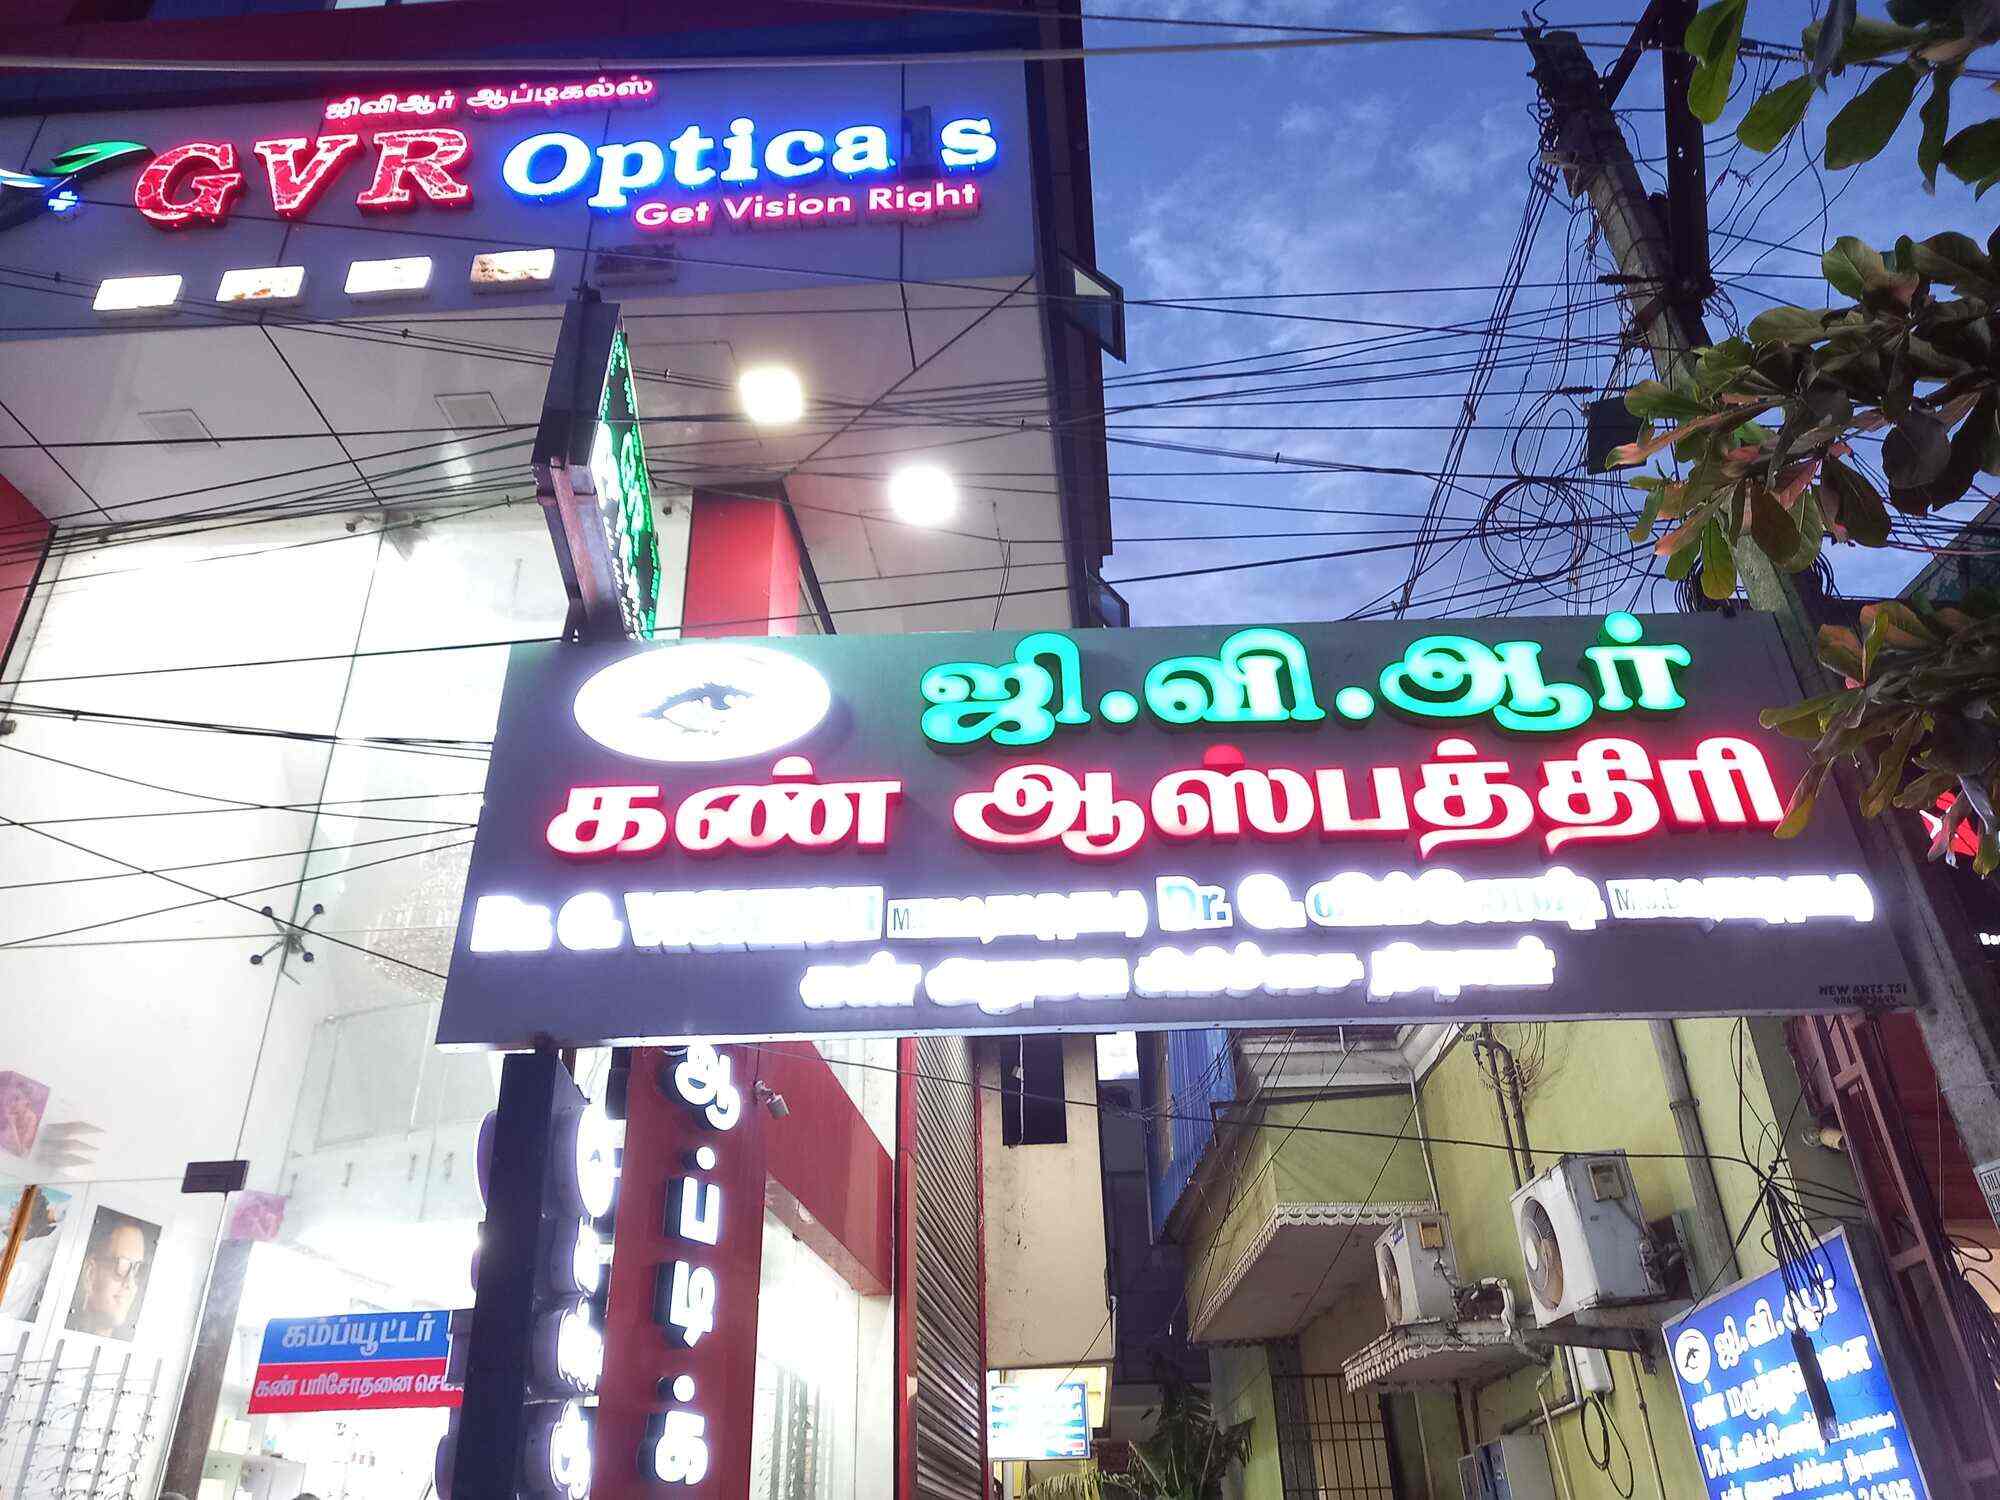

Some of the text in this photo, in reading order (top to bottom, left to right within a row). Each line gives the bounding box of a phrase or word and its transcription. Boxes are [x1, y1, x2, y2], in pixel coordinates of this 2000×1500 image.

[466, 75, 654, 110] ஆப்டிகல்ஸ்
[133, 128, 474, 222] GVR
[634, 182, 977, 228] Get Vision Right
[920, 611, 1692, 748] ஜி.வி.ஆர்
[545, 736, 1790, 860] கண் ஆஸ்பத்திரி
[281, 1312, 437, 1356] கம்ப்யூட்டர்
[254, 1374, 297, 1399] கண்
[300, 1371, 412, 1400] பரிசோதனை
